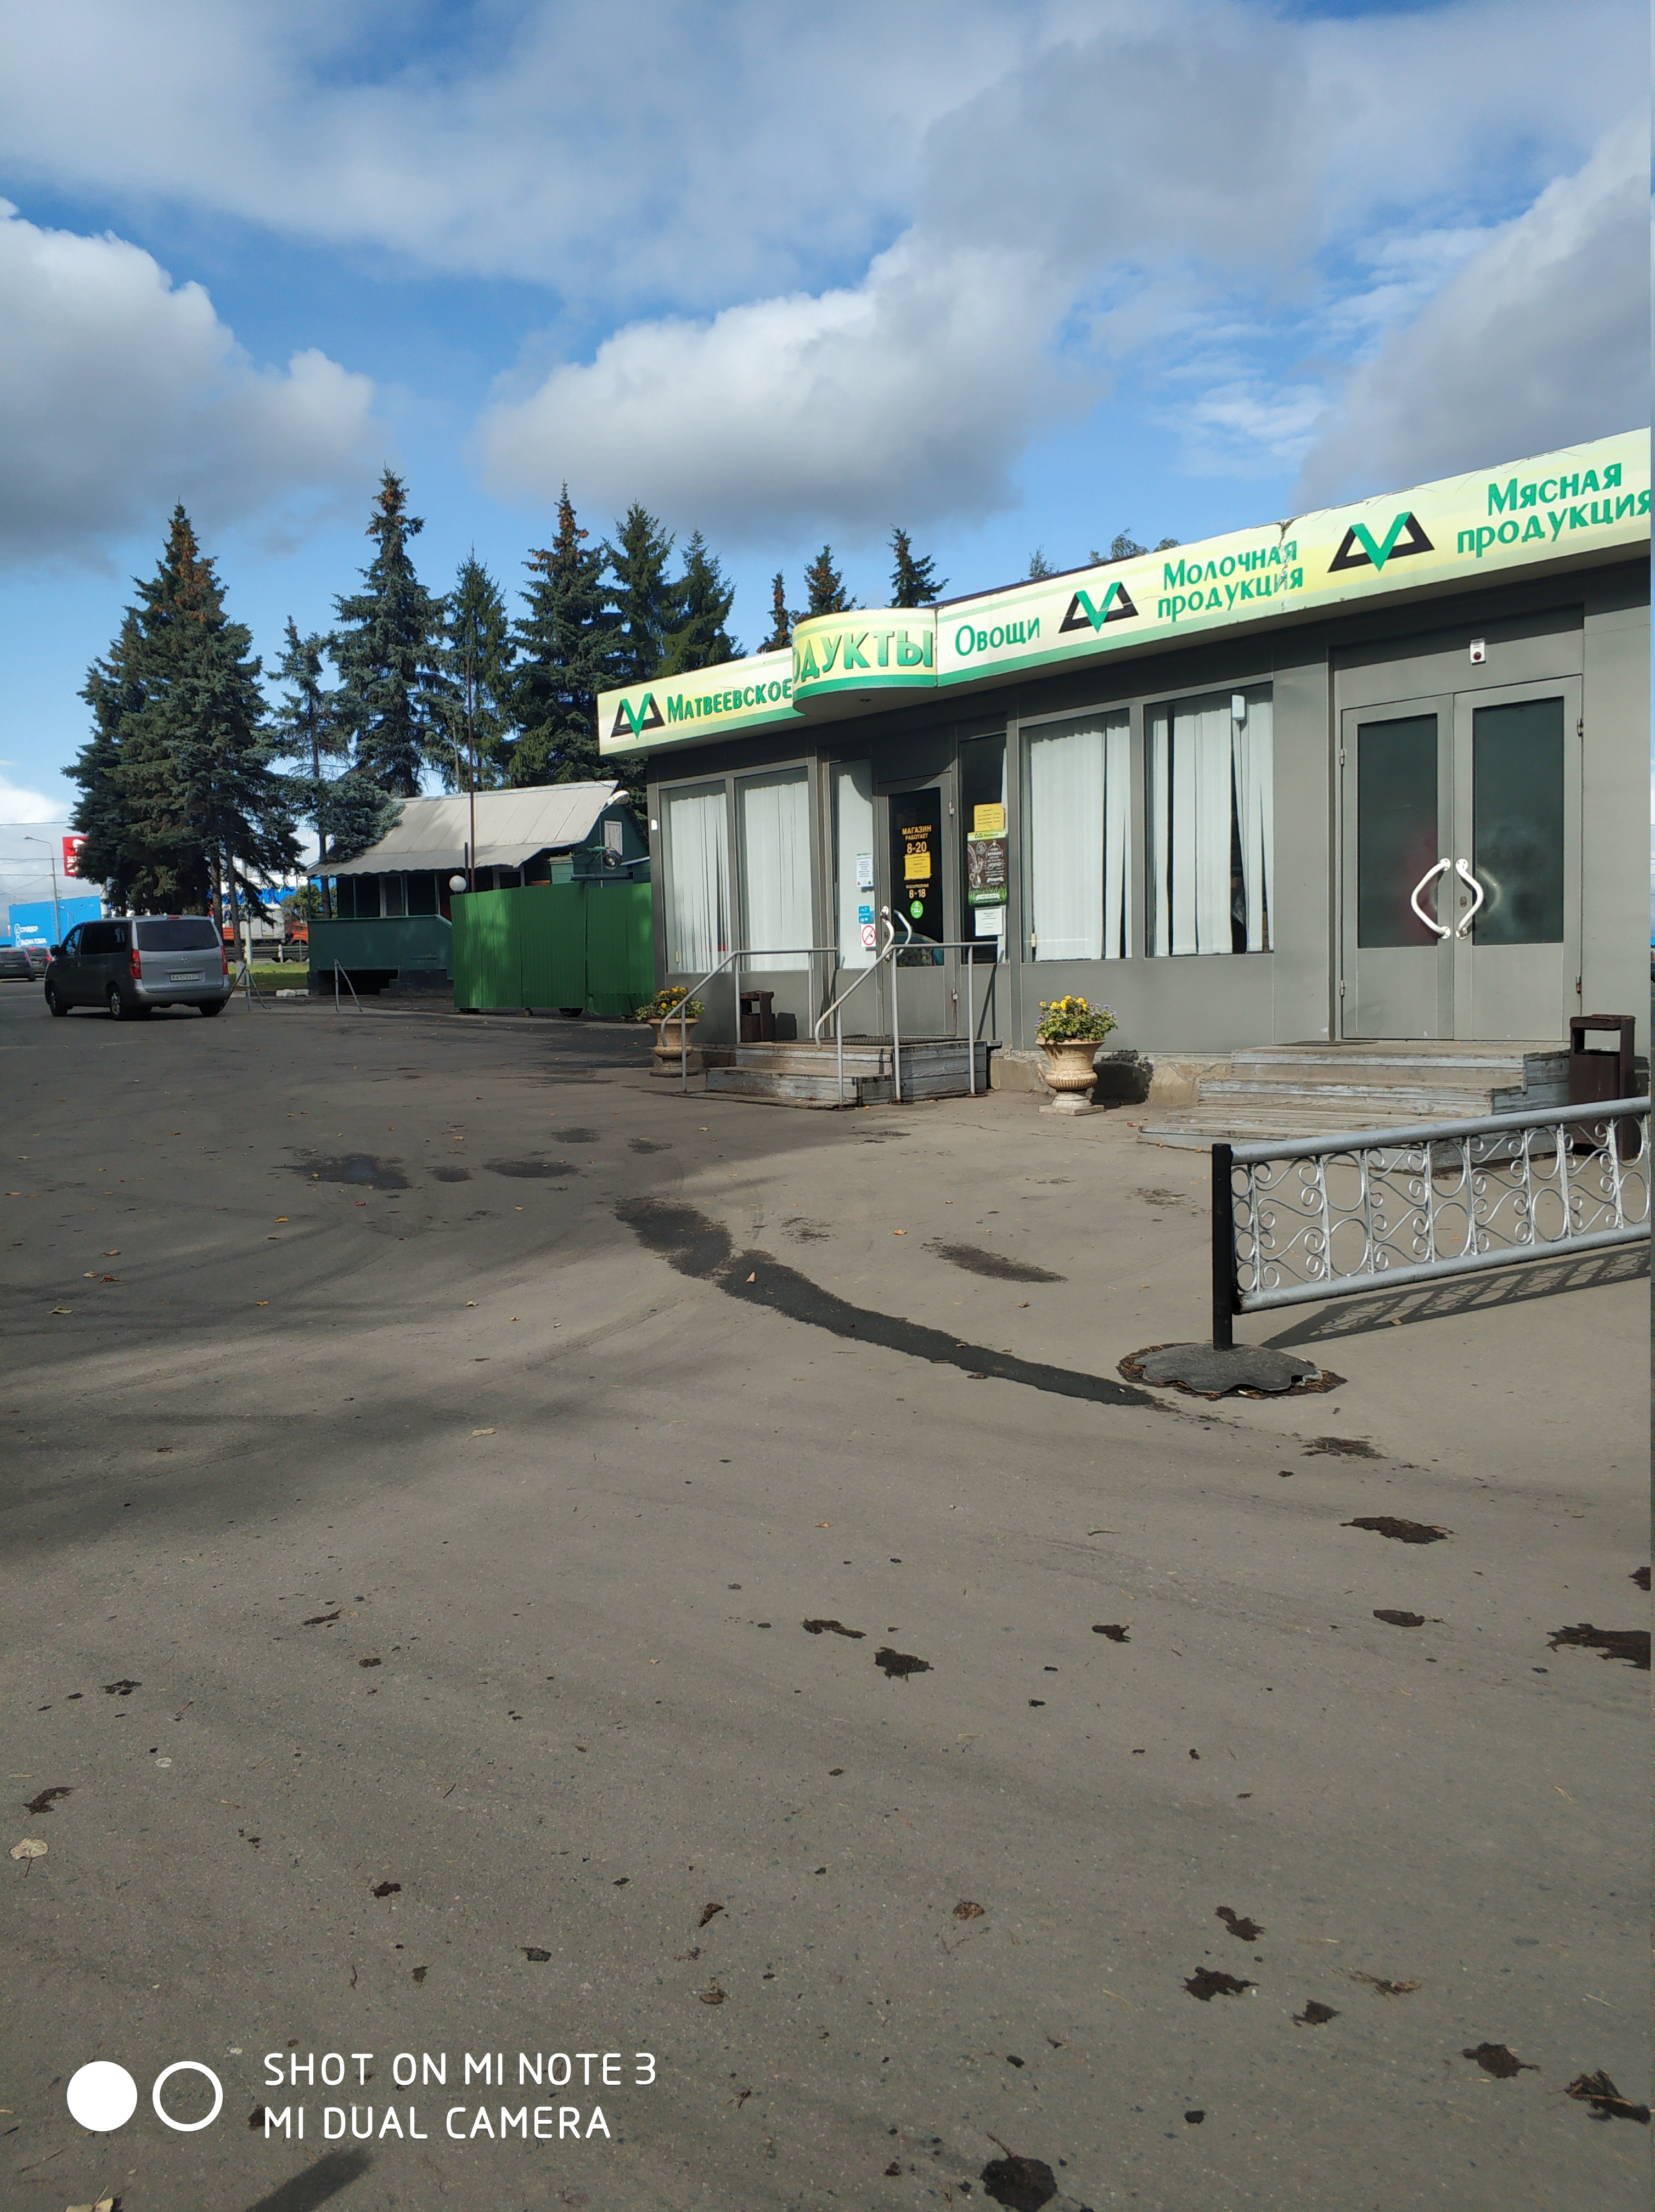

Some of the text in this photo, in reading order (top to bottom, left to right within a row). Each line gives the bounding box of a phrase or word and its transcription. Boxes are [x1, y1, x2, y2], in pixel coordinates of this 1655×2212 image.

[1488, 462, 1622, 516] Мясная
[1457, 489, 1651, 558] продукция
[955, 617, 1040, 656] Овощи
[902, 824, 932, 836] МАГАЗИН
[905, 832, 928, 841] РАБОТАЕТ
[907, 840, 927, 854] 8-20
[909, 888, 926, 899] 8-18
